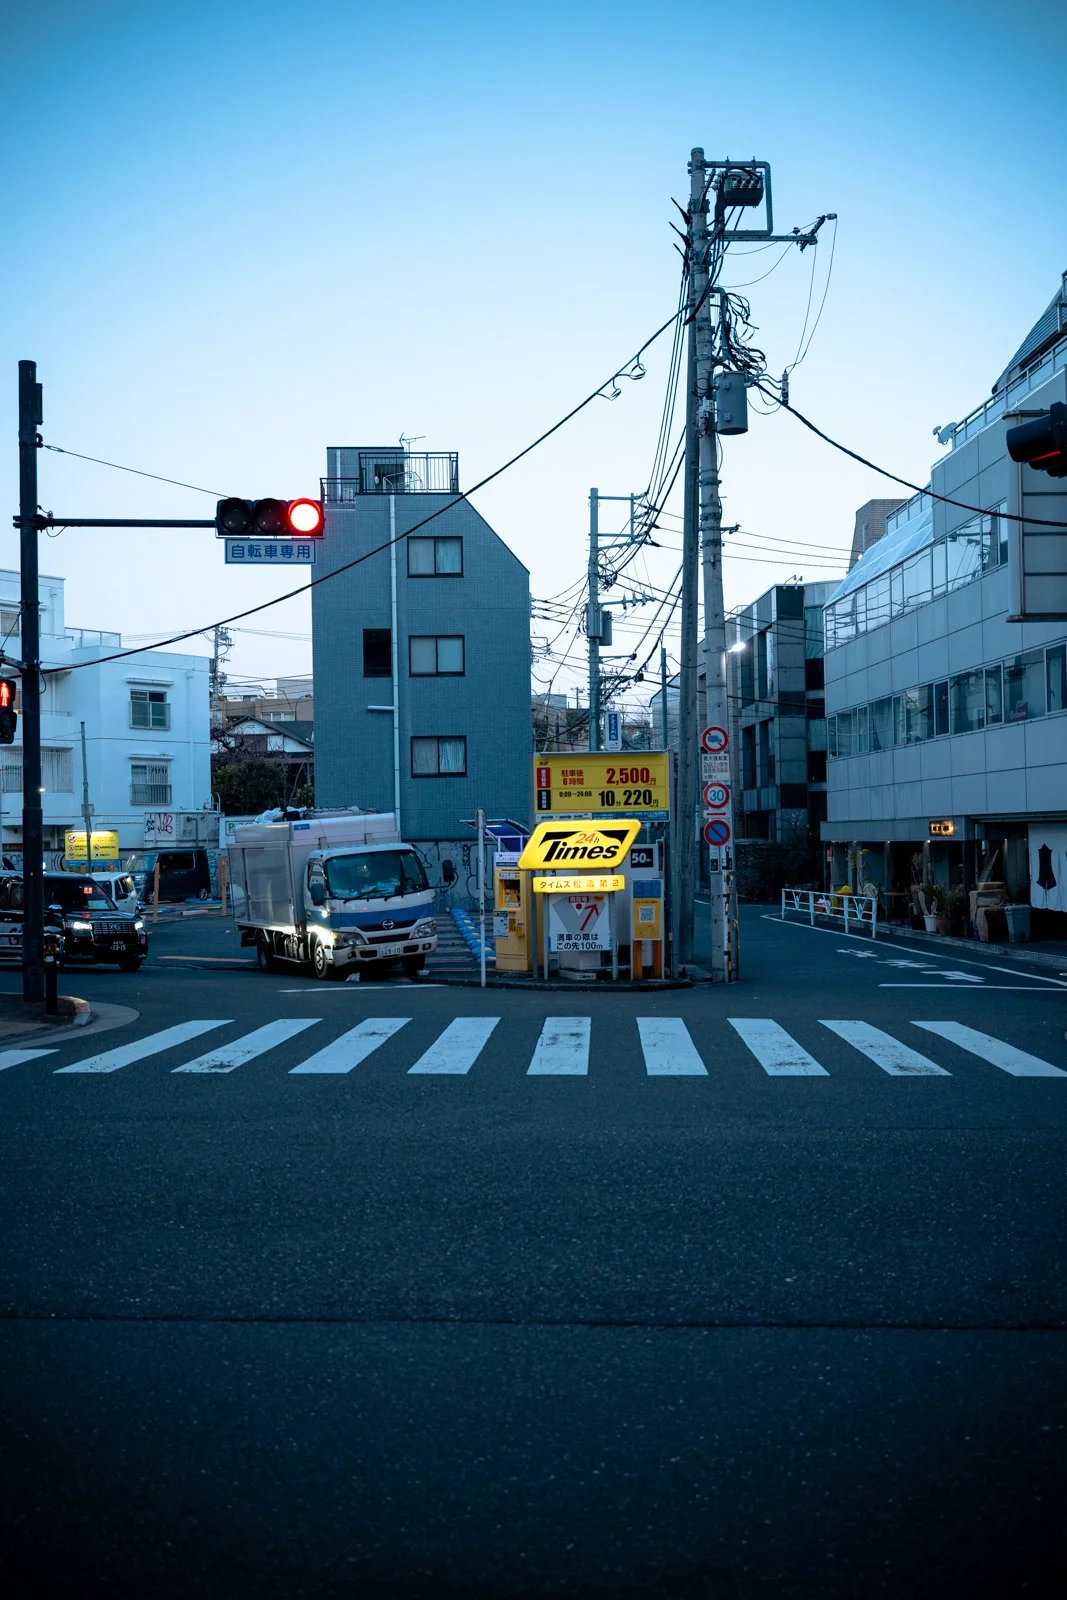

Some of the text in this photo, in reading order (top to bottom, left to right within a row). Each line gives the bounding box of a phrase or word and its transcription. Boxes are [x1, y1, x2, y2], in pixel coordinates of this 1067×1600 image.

[231, 544, 311, 559] 自転車専用
[561, 769, 584, 777] 駐車後
[709, 790, 725, 802] 30
[575, 833, 600, 844] 24h
[541, 838, 621, 862] Times
[556, 942, 603, 950] この先100m
